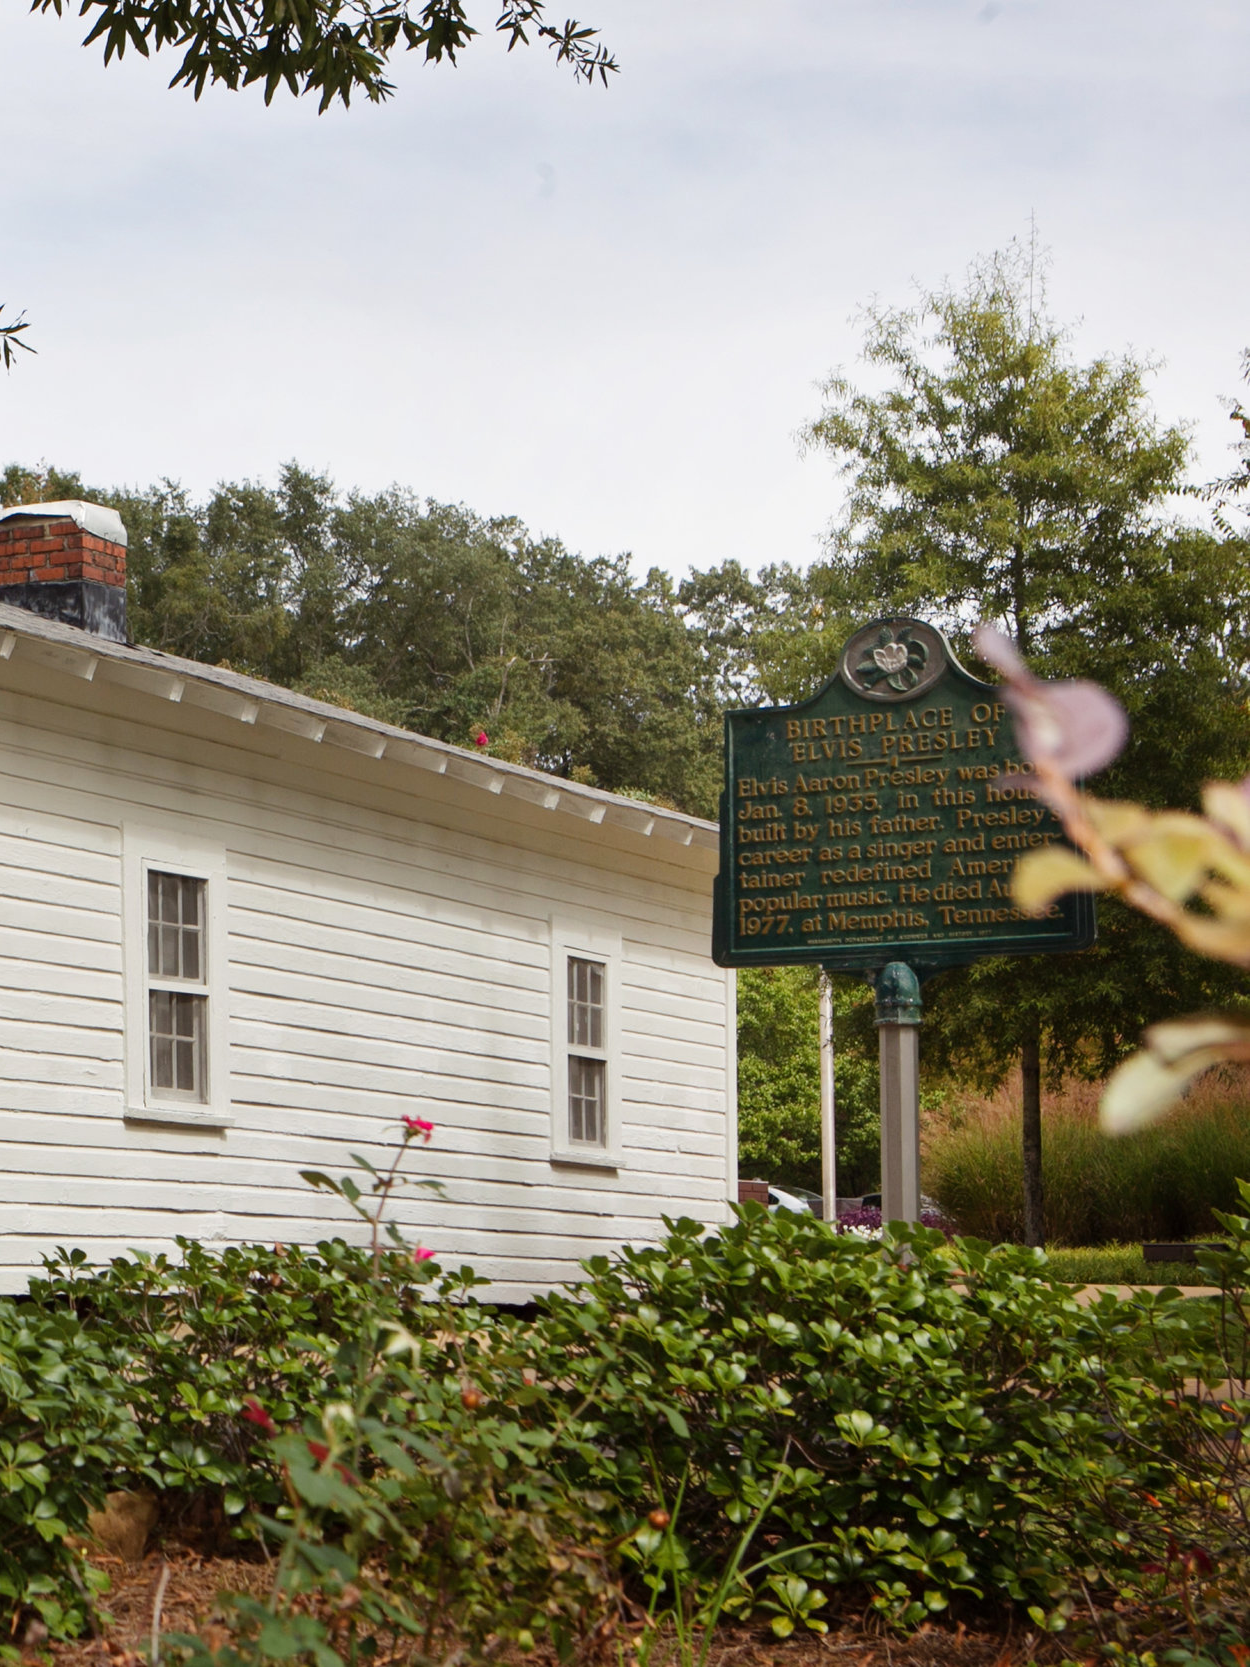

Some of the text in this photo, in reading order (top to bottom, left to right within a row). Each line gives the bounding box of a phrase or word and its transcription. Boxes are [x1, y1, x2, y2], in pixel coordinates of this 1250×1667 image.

[786, 703, 1006, 740] BIRTHPLACE OF
[791, 727, 999, 762] ELVIS PRESLEY
[737, 776, 789, 797] Elvis
[792, 773, 861, 794] Aaron
[864, 765, 950, 789] Presley
[957, 764, 999, 781] was
[737, 801, 782, 820] Jan.
[897, 791, 919, 809] in
[931, 786, 976, 807] this
[737, 823, 786, 843] built
[793, 820, 821, 842] by
[828, 818, 862, 838] his
[869, 814, 945, 834] father.
[738, 830, 1062, 866] career as a singer and enter-
[738, 870, 806, 889] tainer
[820, 860, 932, 885] redefined
[738, 891, 823, 915] popular
[826, 887, 893, 908] music.
[898, 884, 930, 903] He
[932, 880, 982, 901] died
[801, 914, 823, 933] at
